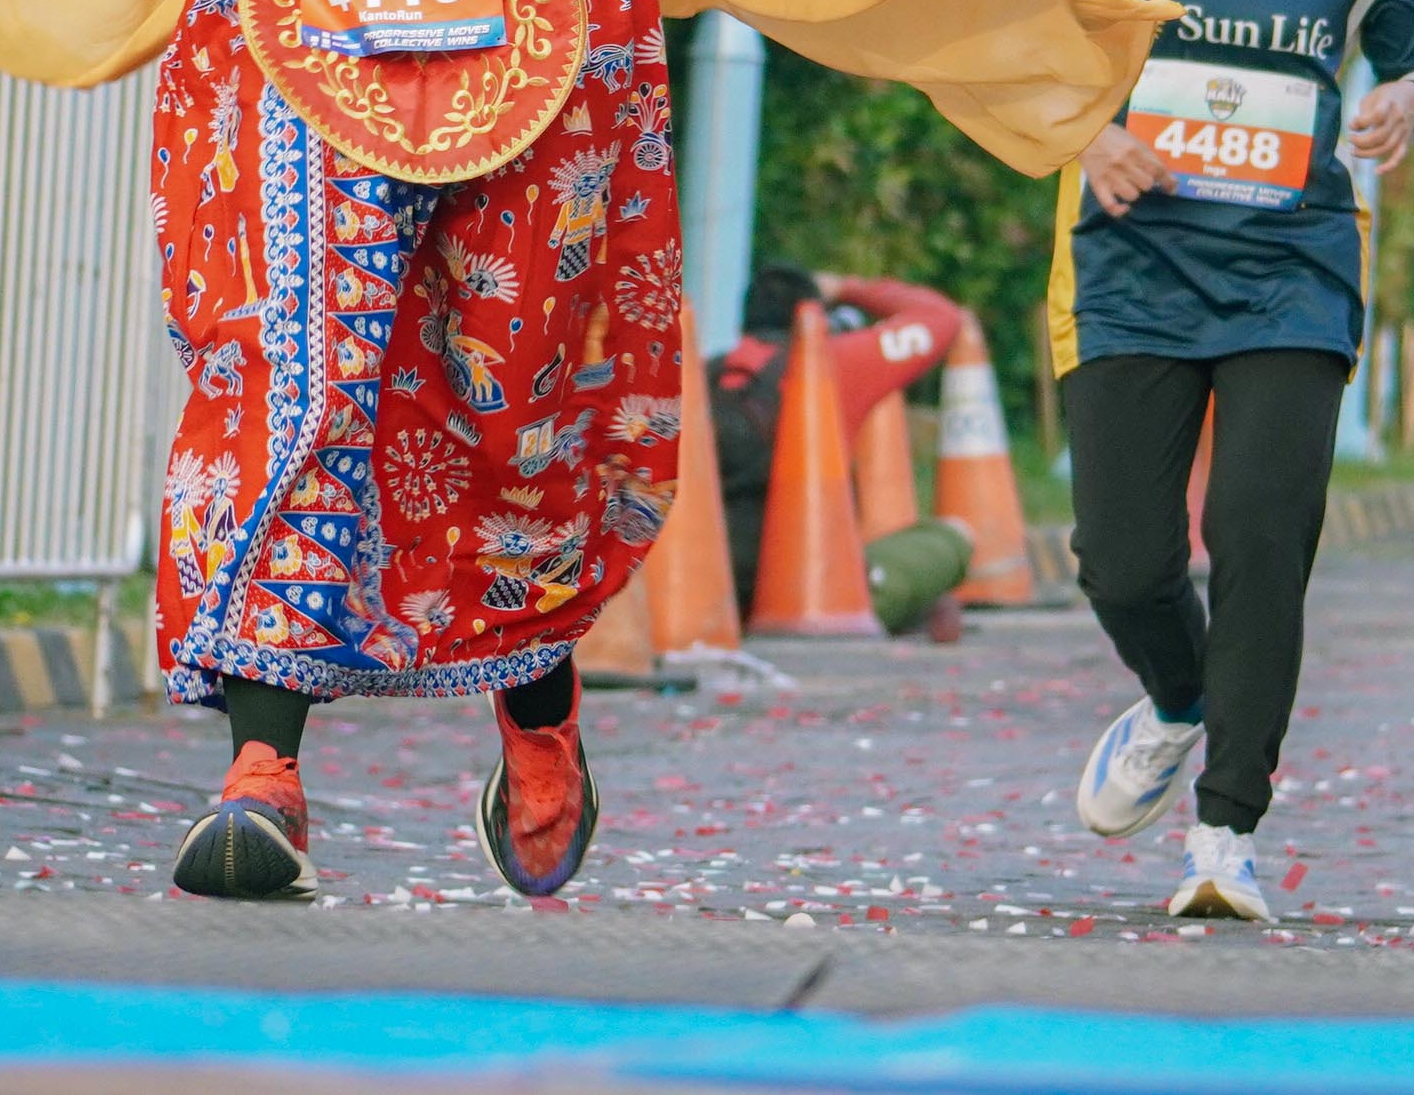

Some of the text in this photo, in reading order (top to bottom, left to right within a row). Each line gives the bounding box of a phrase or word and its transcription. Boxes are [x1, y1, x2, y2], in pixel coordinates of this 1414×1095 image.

[358, 9, 423, 23] KantoRun
[364, 29, 445, 42] PROGRESSIVE
[448, 25, 491, 35] MOVES
[1177, 4, 1334, 61] Sun Life
[373, 36, 444, 49] COLLECTIVE
[447, 36, 479, 46] WINS
[1154, 120, 1282, 170] 4488
